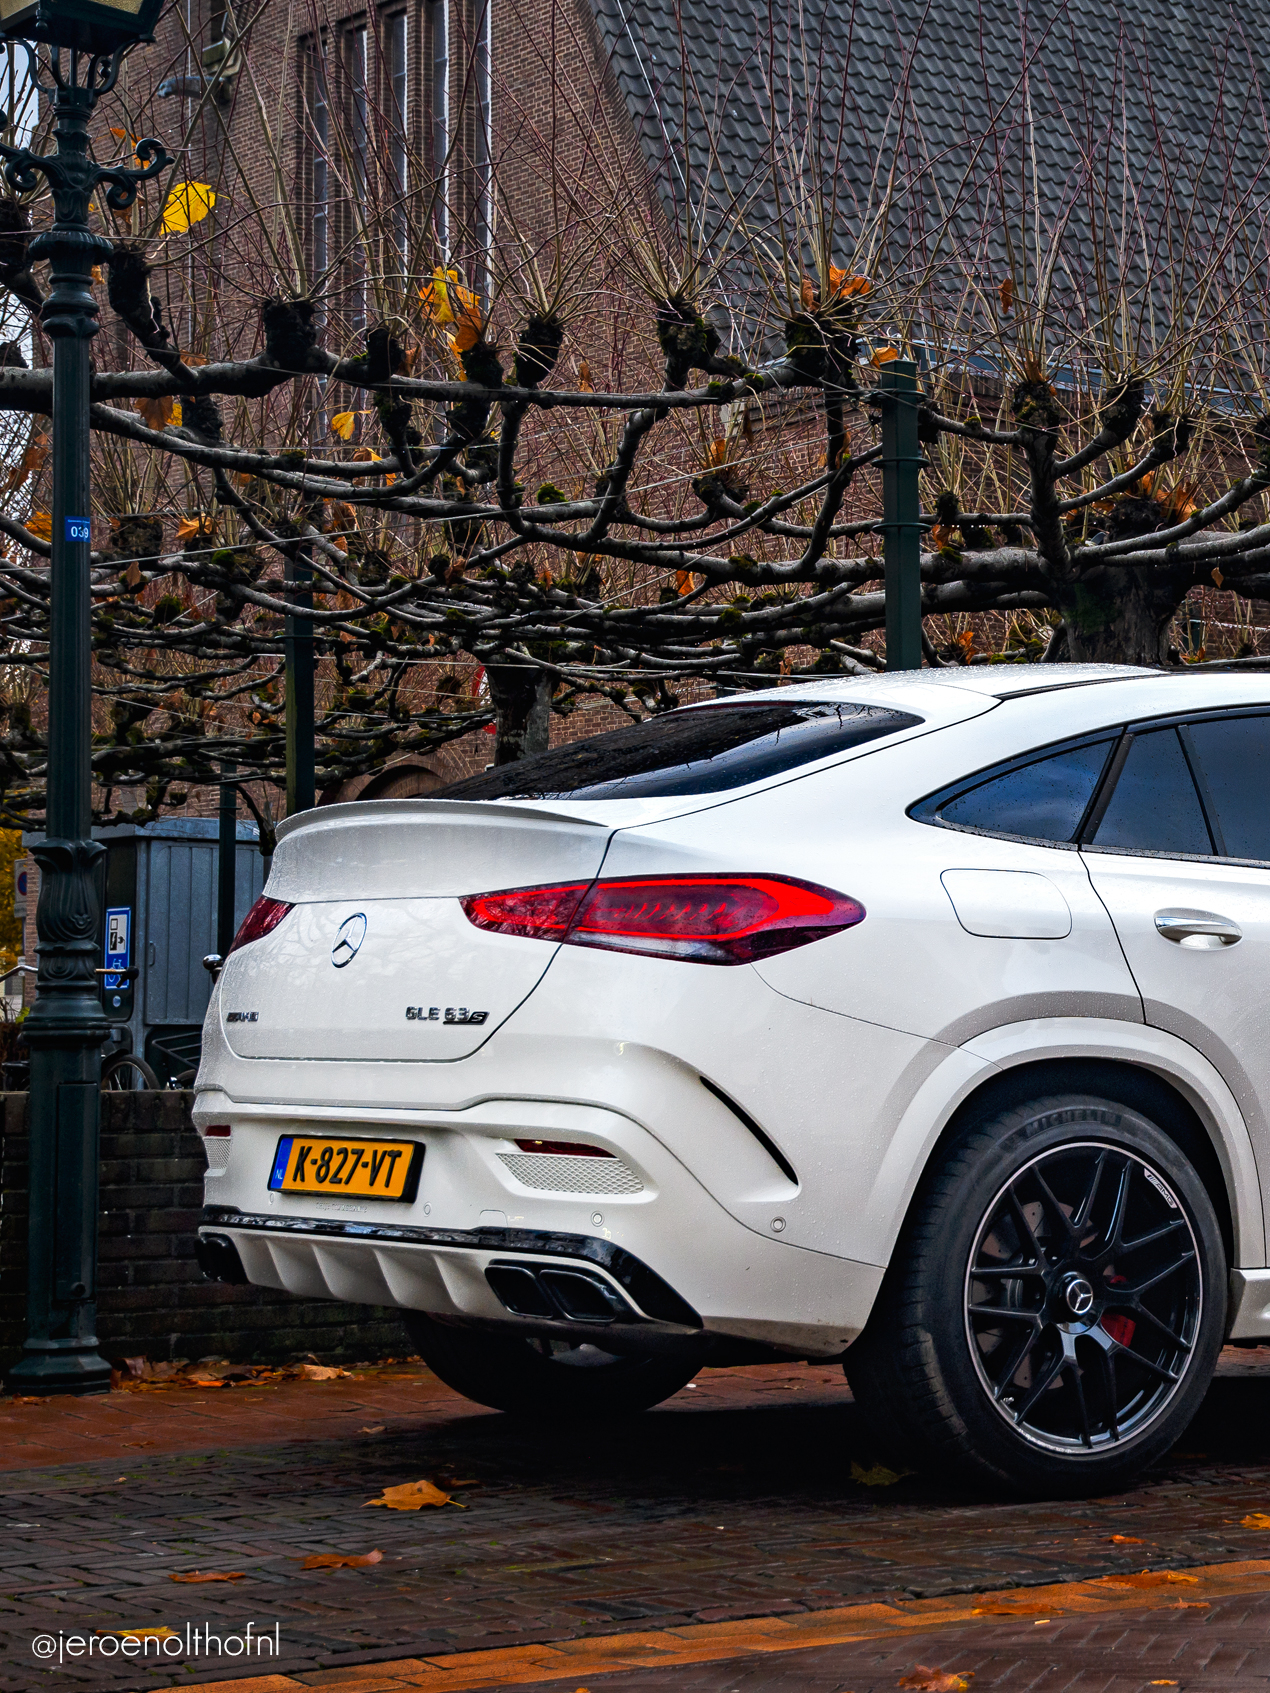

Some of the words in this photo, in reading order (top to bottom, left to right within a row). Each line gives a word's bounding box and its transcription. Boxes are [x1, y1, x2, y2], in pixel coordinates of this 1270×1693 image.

[405, 1006, 441, 1021] GLE
[275, 1168, 284, 1180] NL
[292, 1145, 403, 1189] K-827-VT
